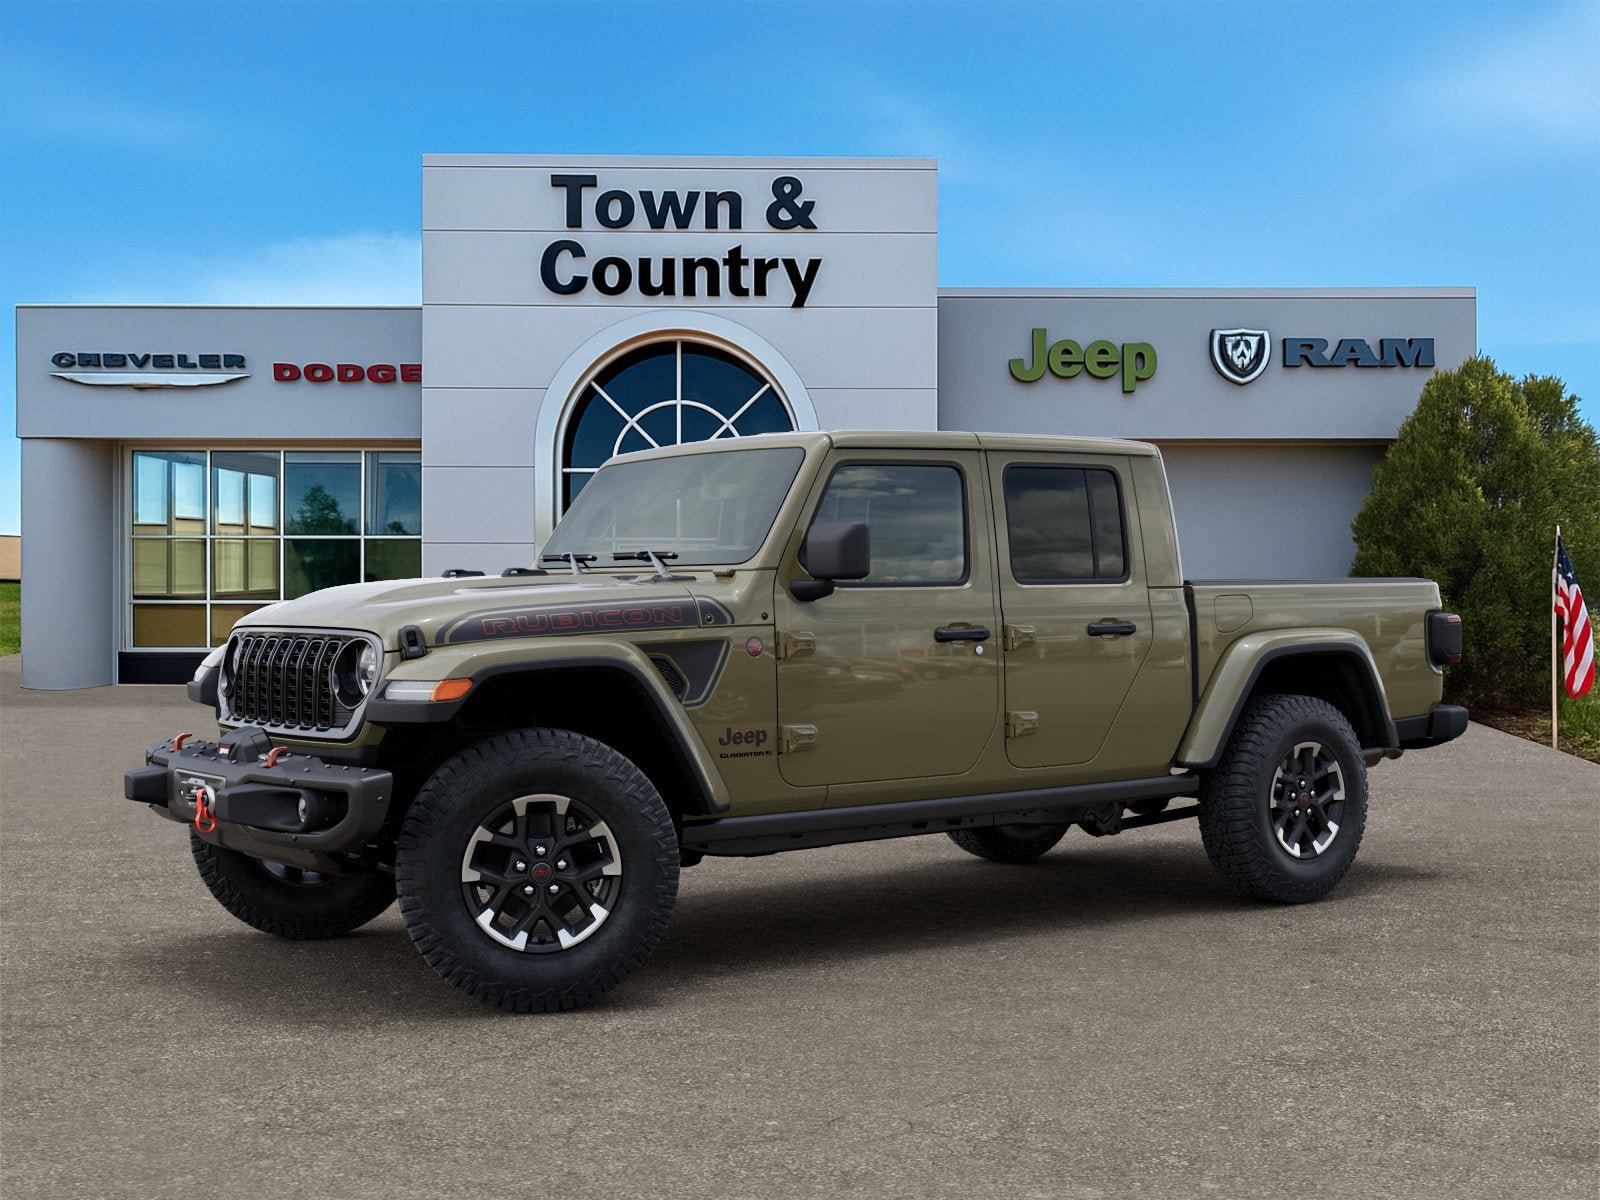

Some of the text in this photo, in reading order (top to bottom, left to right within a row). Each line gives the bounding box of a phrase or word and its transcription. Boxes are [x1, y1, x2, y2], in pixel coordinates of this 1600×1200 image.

[551, 174, 818, 230] Town &
[540, 239, 822, 308] Country
[1009, 327, 1158, 393] Jeep
[1282, 337, 1436, 368] RAM
[273, 363, 422, 383] DODGE
[481, 606, 684, 635] RUBICON
[718, 727, 768, 747] Jeep
